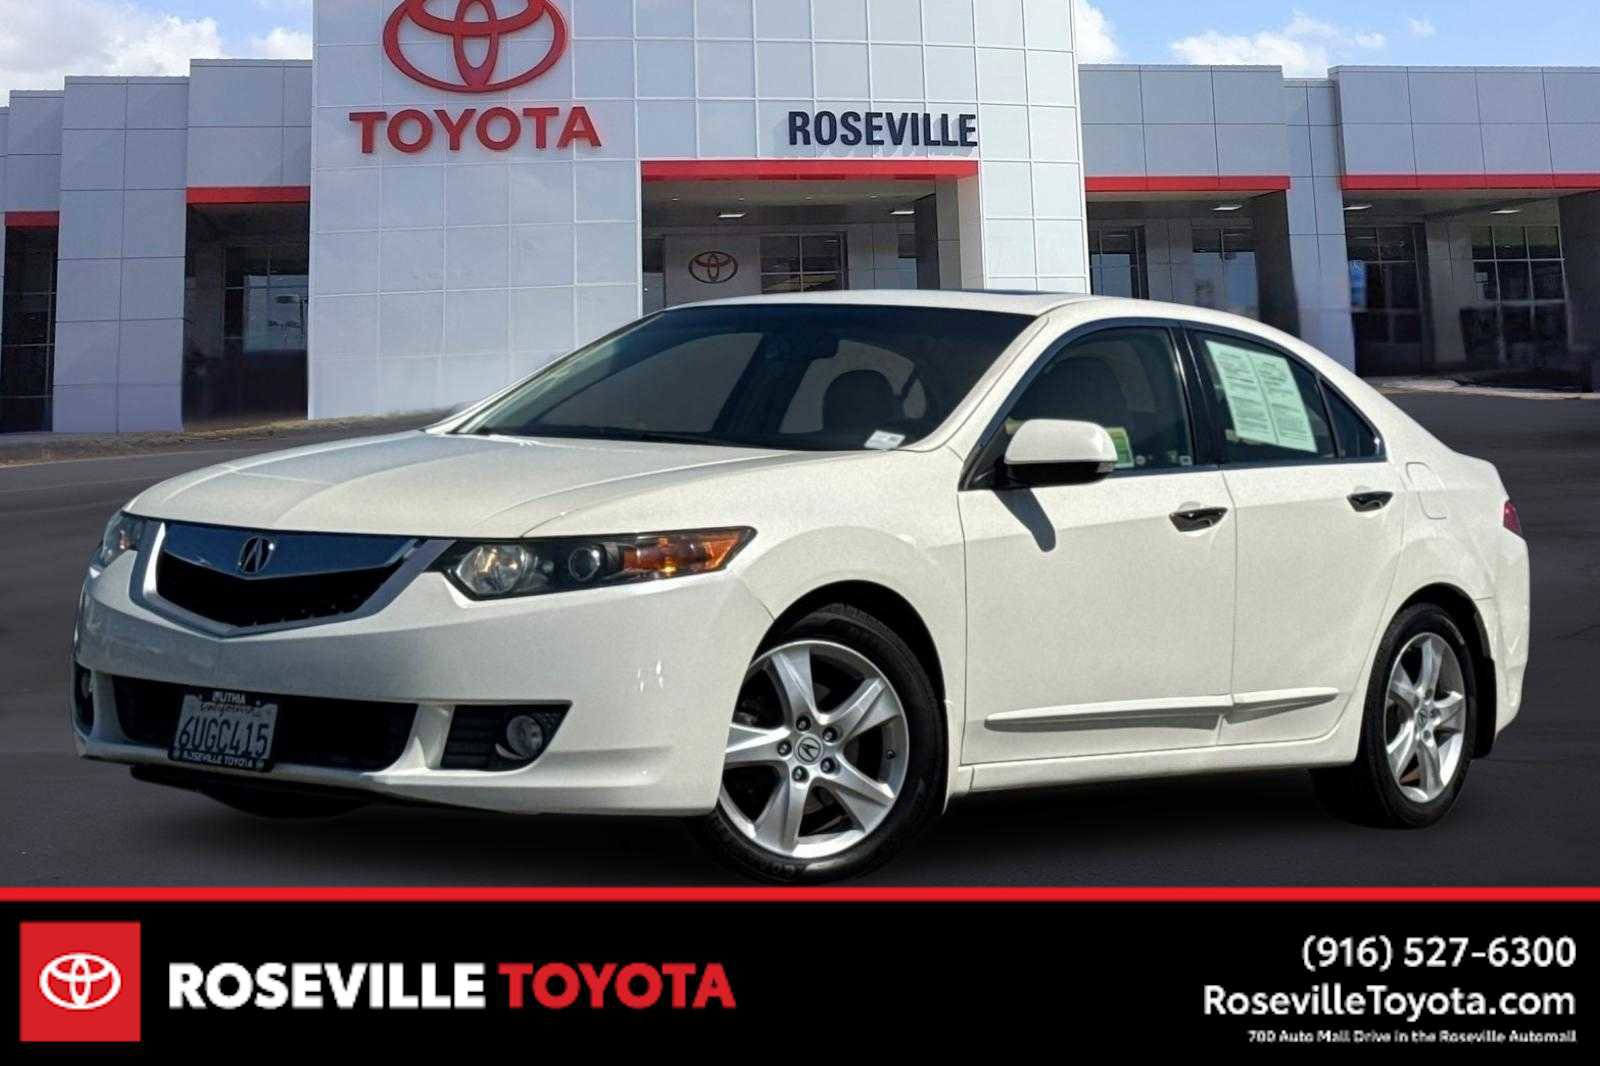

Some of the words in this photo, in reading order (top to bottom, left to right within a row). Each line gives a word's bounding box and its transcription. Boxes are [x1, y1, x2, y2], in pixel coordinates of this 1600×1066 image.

[349, 106, 602, 153] TOYOTA
[789, 111, 978, 147] ROSEVILLE
[178, 716, 270, 758] 6UGC415
[223, 755, 254, 769] TOYOTA
